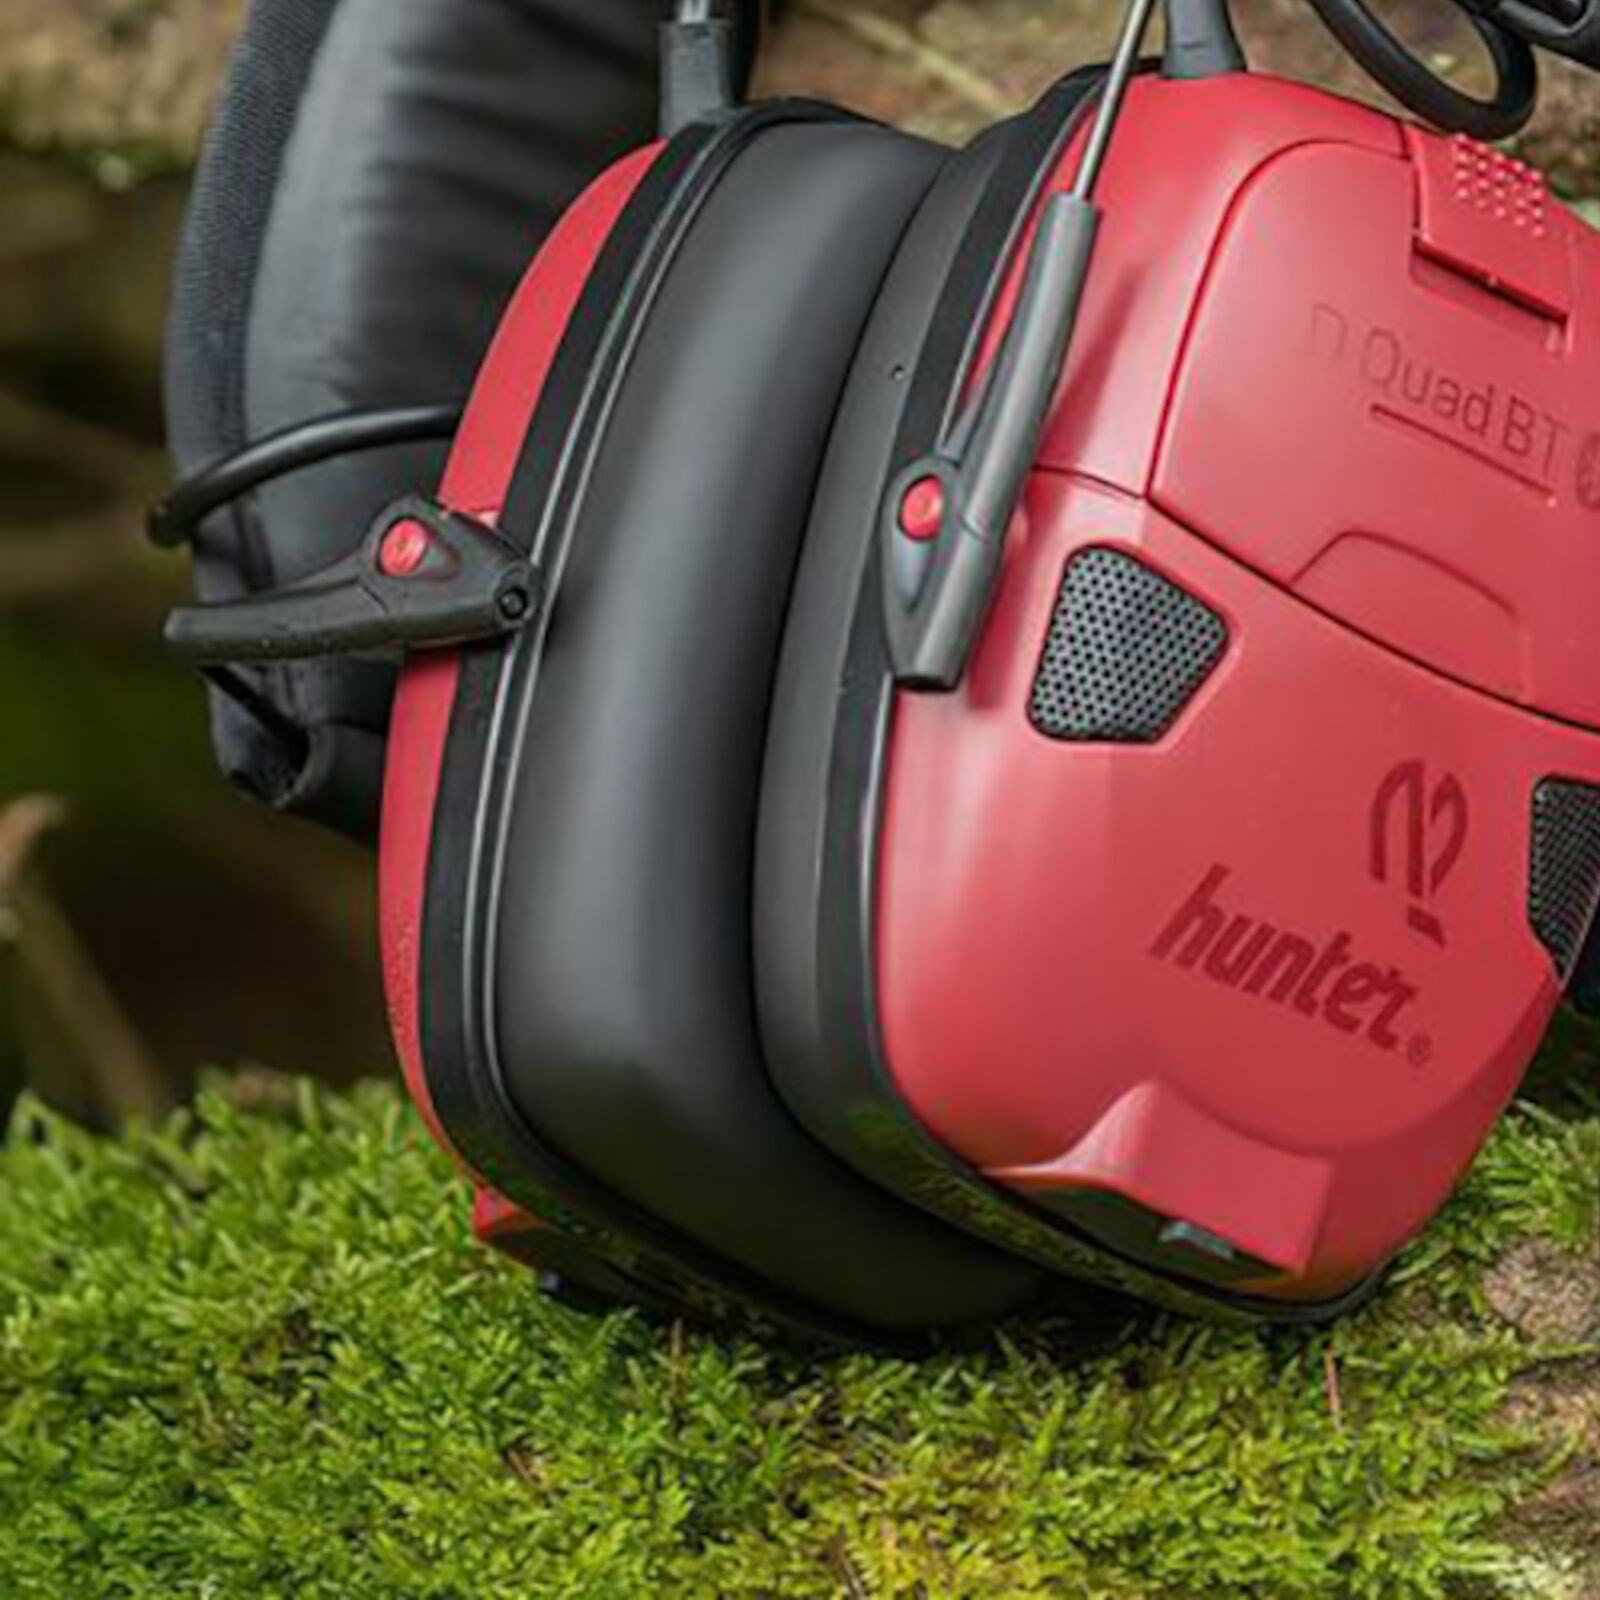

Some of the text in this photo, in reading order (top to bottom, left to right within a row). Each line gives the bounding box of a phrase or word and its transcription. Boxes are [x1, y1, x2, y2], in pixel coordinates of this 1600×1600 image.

[1359, 326, 1495, 437] Quad
[1502, 394, 1571, 481] BT
[1149, 862, 1420, 1052] hunter
